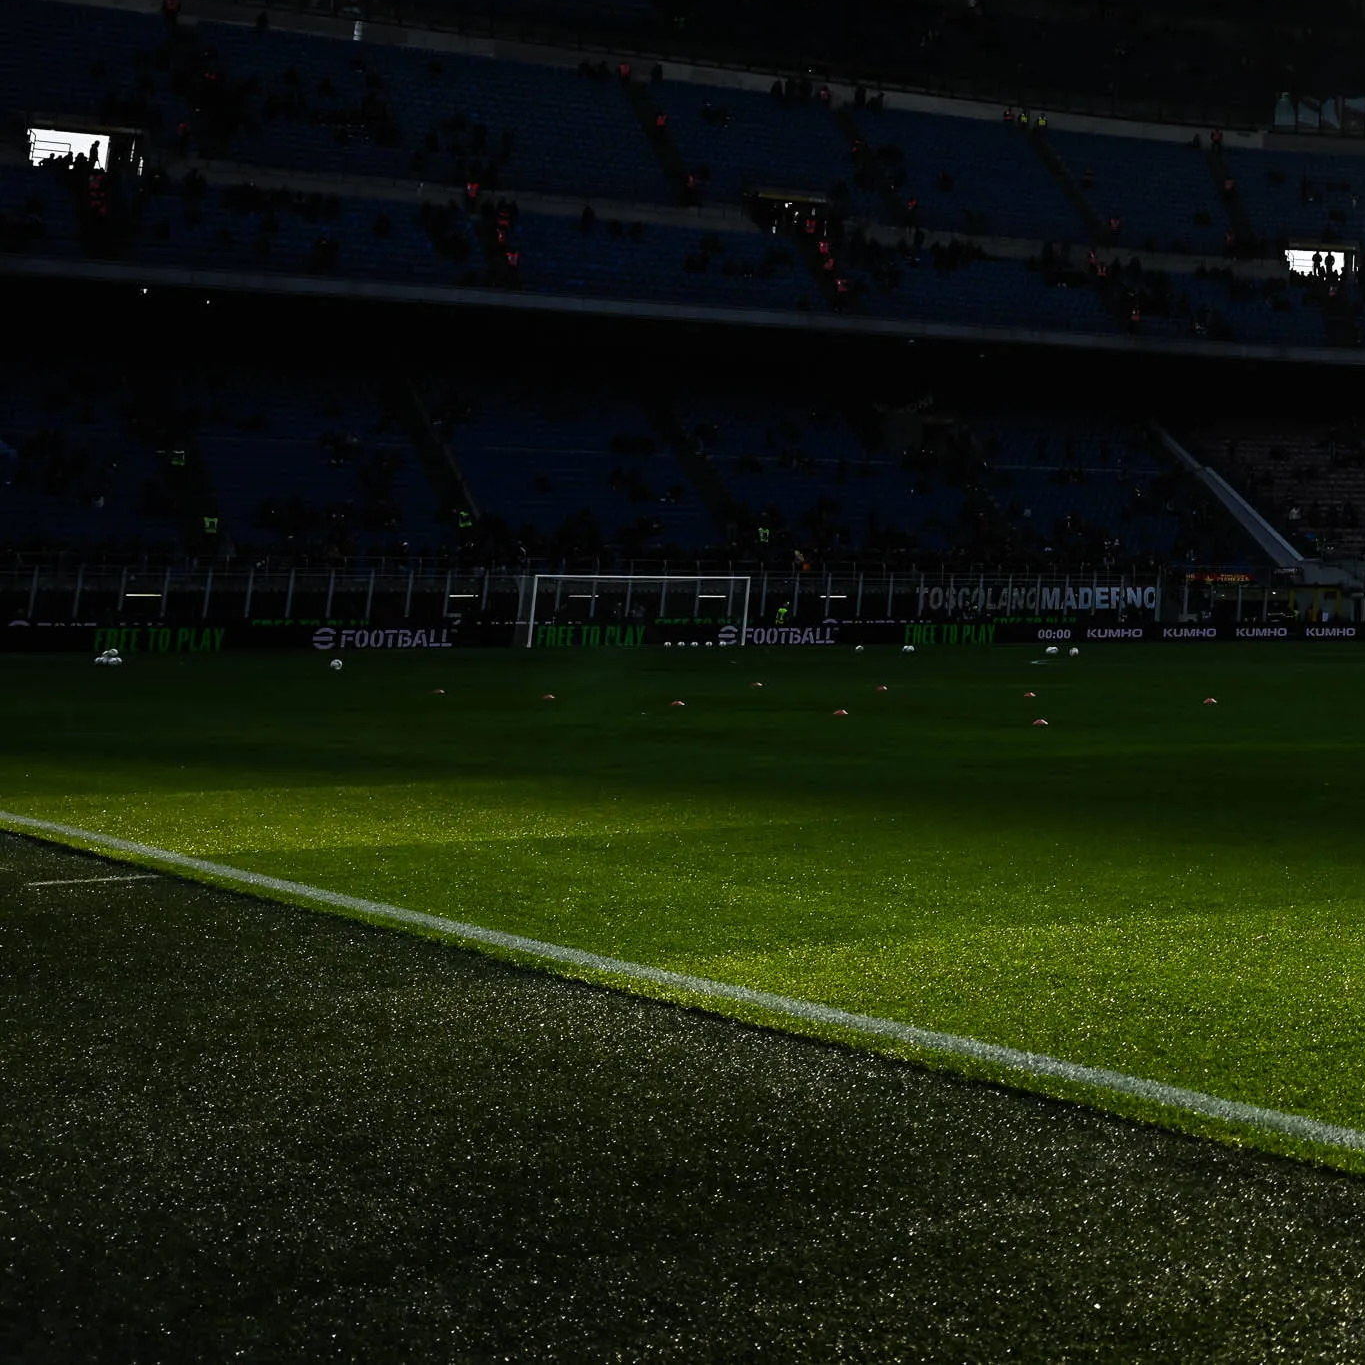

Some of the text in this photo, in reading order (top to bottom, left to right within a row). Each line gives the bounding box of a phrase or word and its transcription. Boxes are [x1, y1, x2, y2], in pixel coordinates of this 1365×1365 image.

[1041, 587, 1157, 611] MADERNO
[904, 623, 997, 644] FREE TO PLAY
[1037, 629, 1071, 640] 00:00
[1086, 628, 1143, 639] KUMHO
[1163, 627, 1217, 638] KUMHO
[1236, 627, 1288, 638] KUMHO
[1306, 626, 1356, 638] KUMHO
